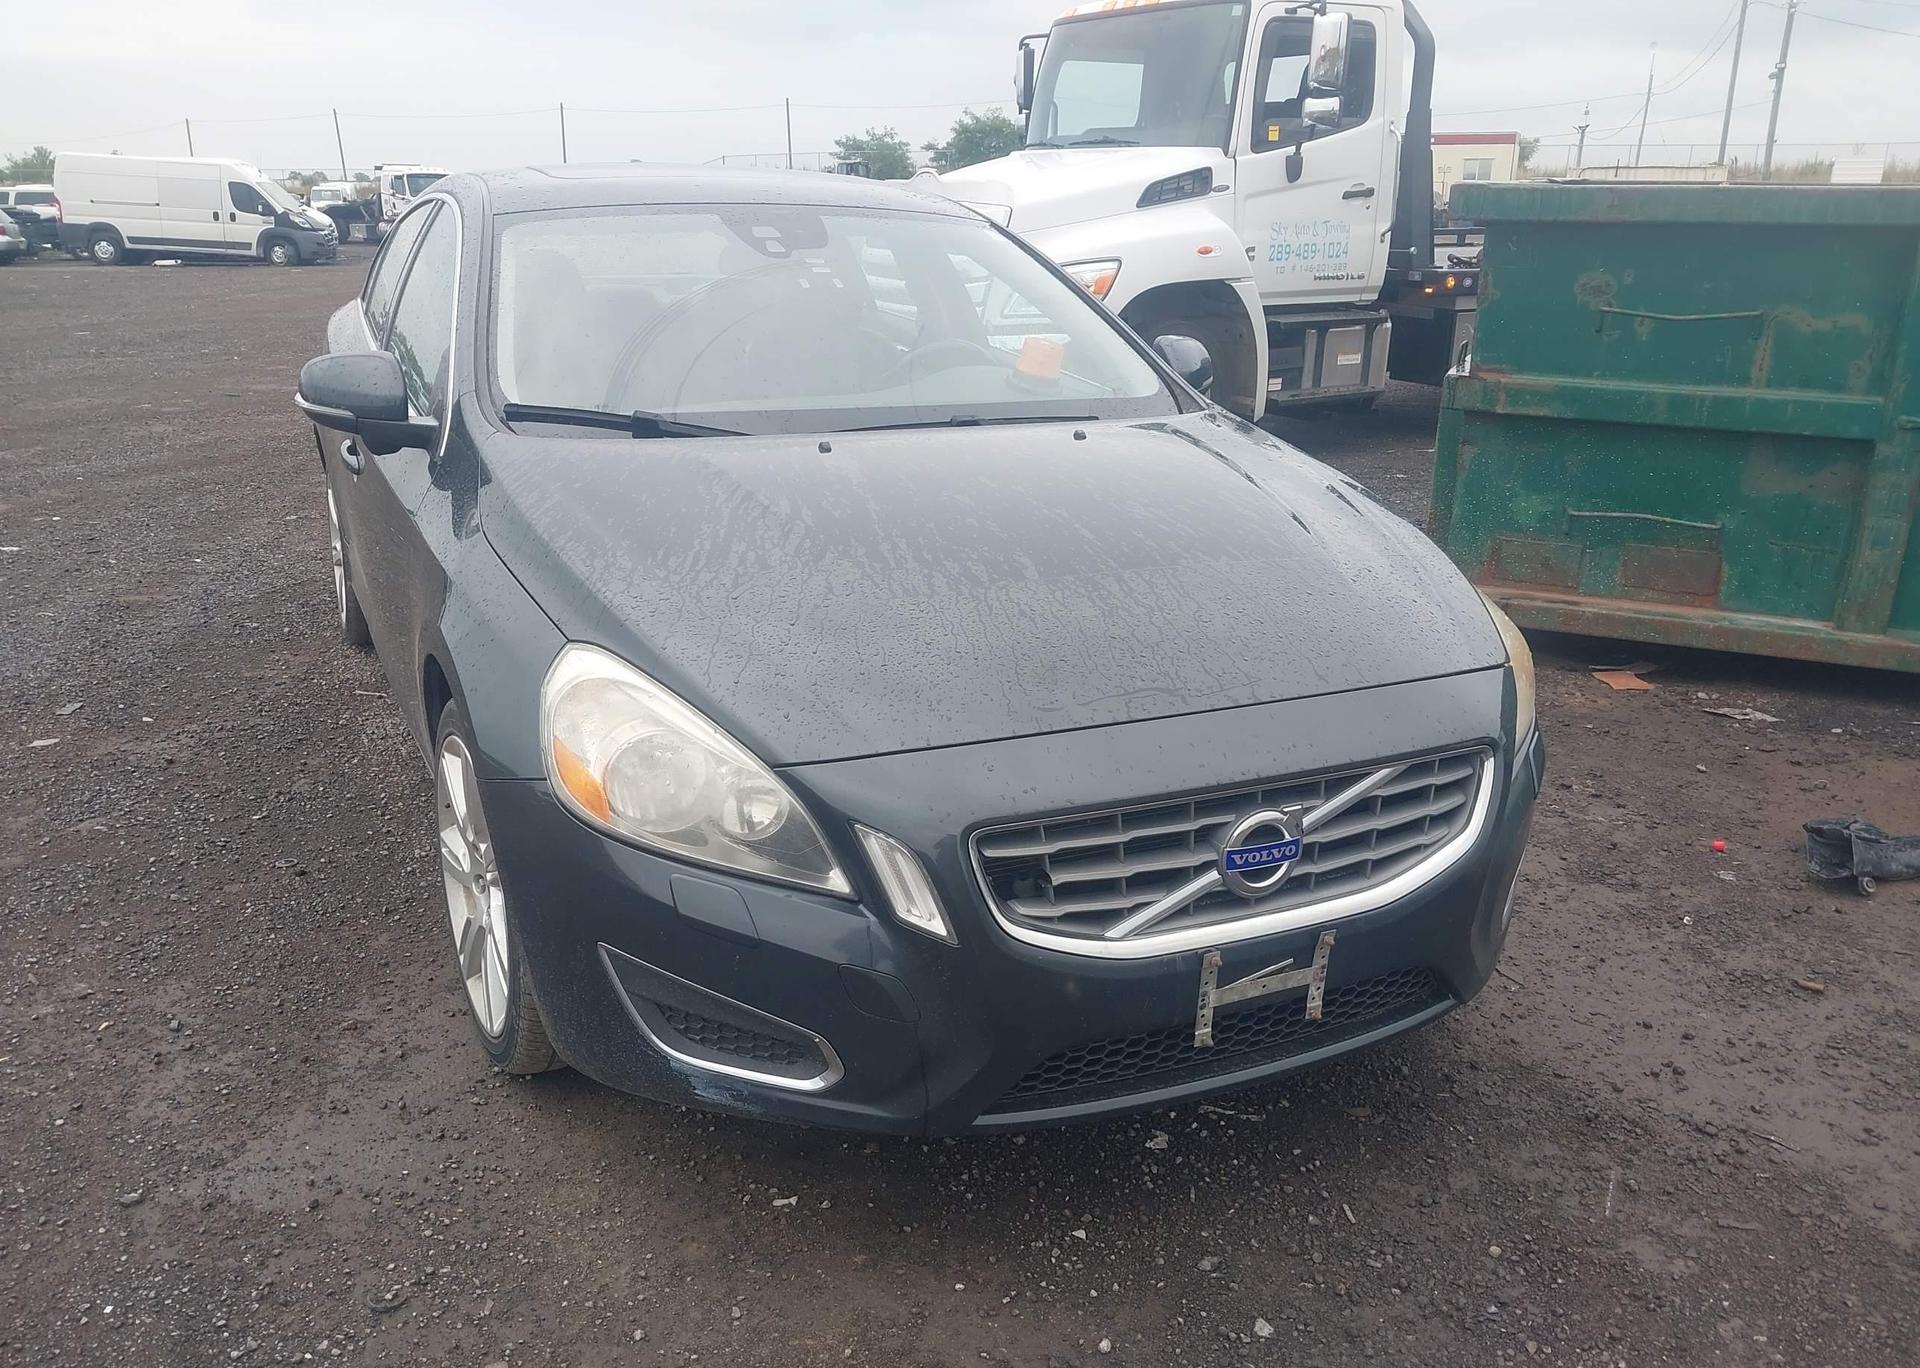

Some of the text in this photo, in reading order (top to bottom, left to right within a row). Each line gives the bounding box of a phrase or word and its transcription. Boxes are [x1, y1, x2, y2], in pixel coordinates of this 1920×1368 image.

[1270, 220, 1351, 242] Sky Auto & Towing
[1231, 845, 1296, 865] VOLVO
